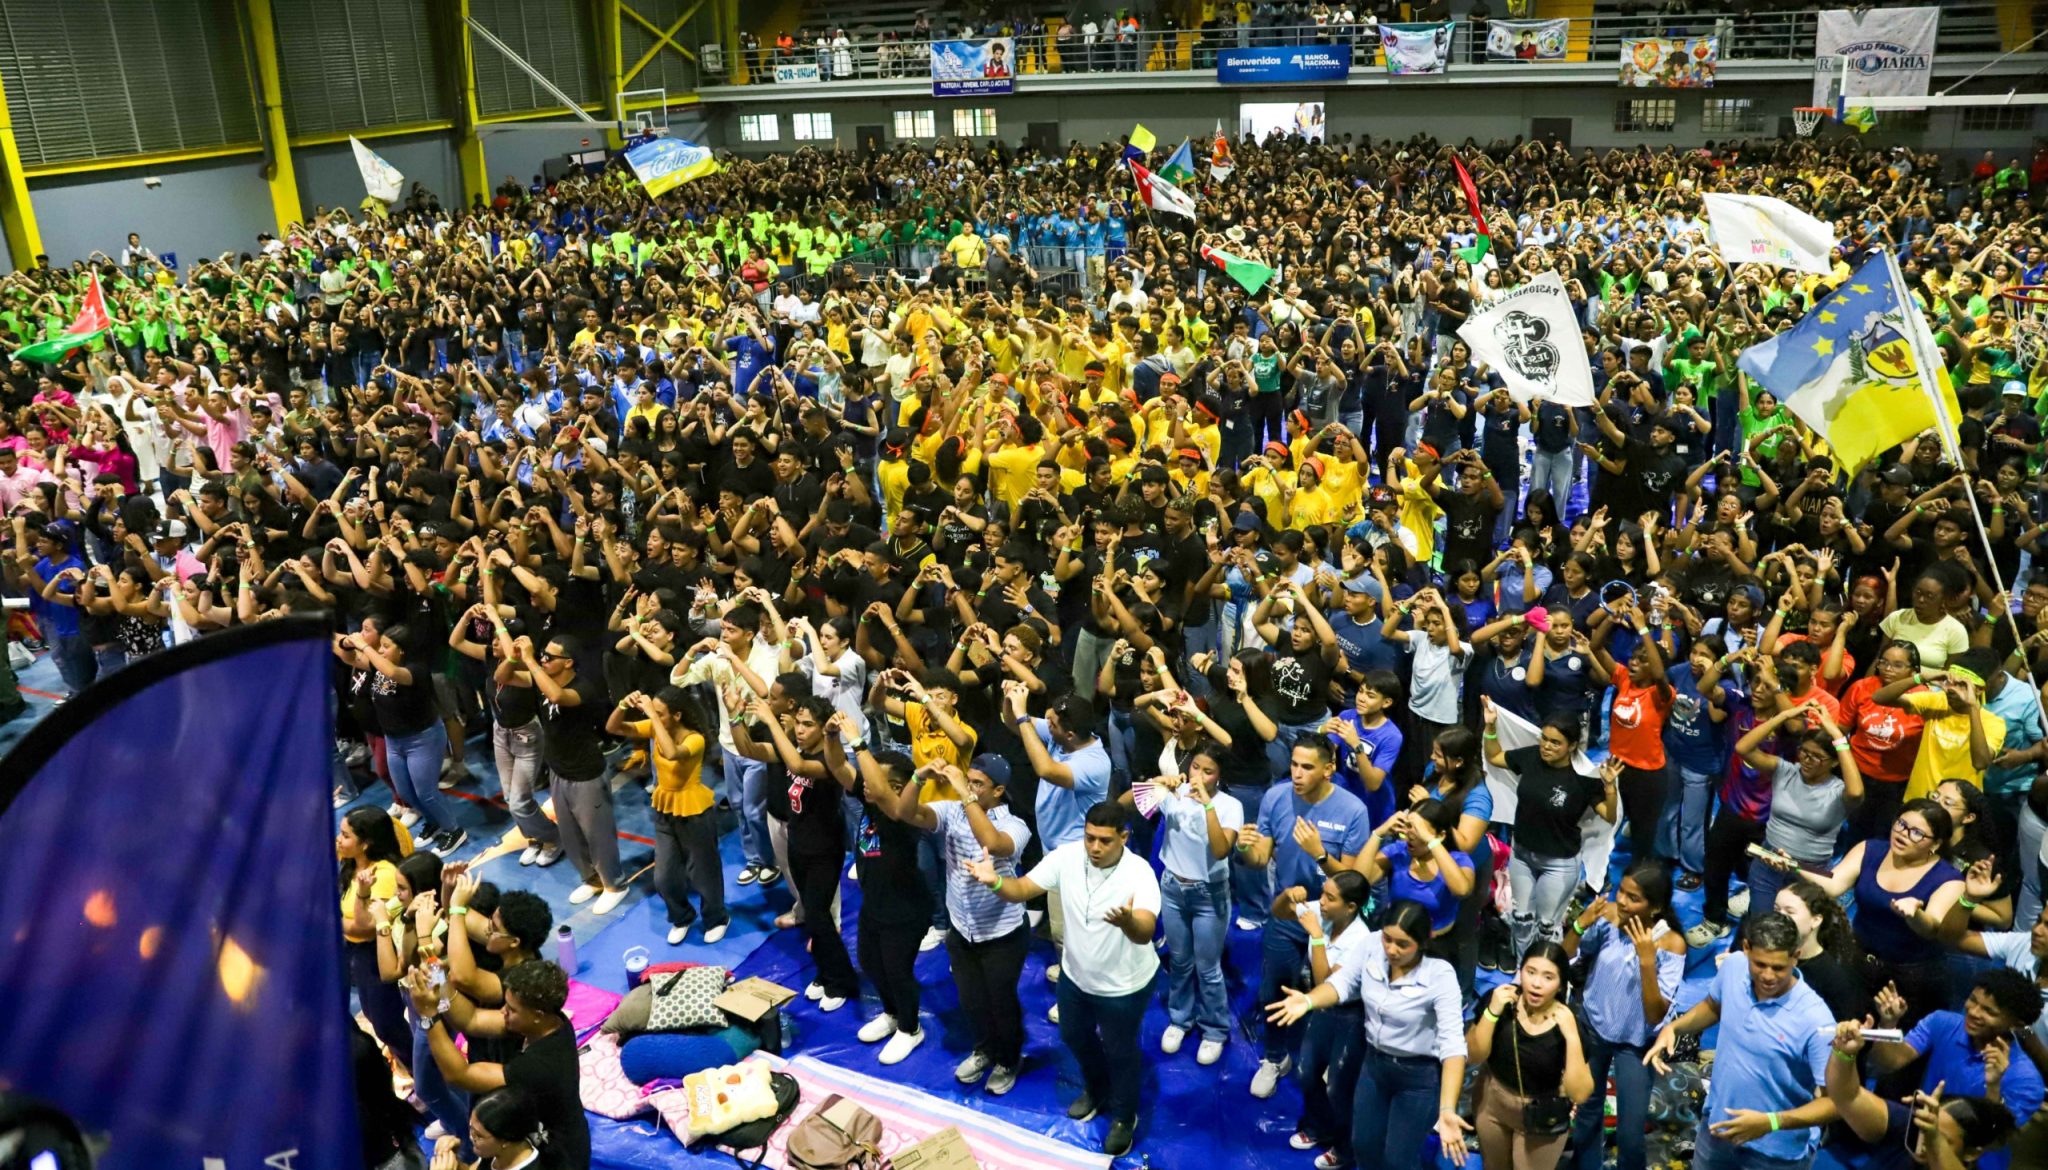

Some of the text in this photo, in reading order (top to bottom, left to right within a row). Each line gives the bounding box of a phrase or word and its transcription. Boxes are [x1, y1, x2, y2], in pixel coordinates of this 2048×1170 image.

[1838, 43, 1906, 56] WORLD FAMILY
[1226, 56, 1281, 66] Bienvenidos
